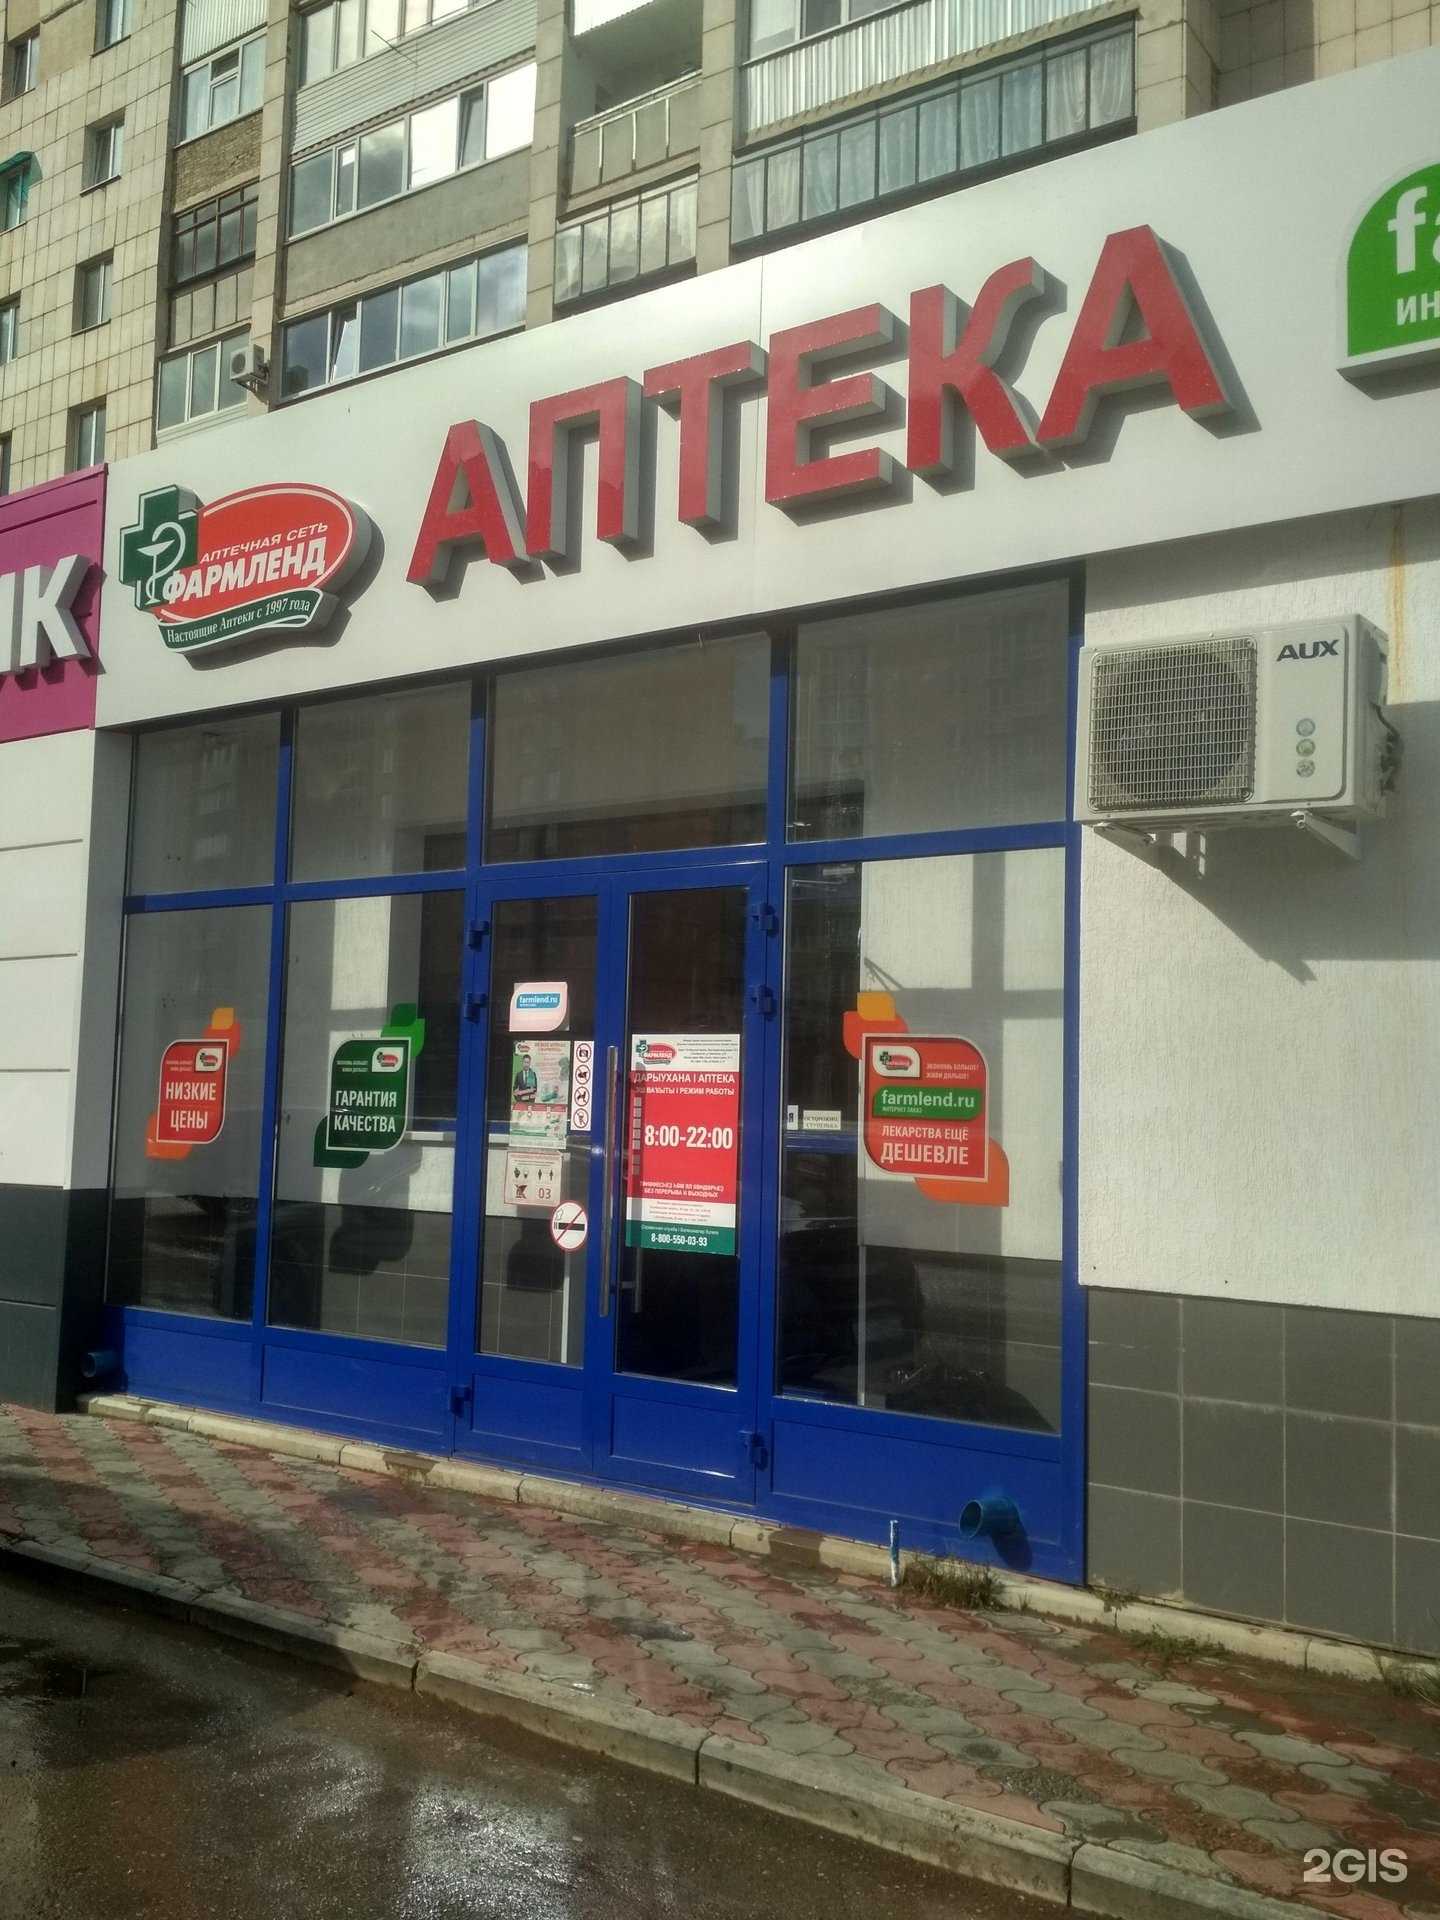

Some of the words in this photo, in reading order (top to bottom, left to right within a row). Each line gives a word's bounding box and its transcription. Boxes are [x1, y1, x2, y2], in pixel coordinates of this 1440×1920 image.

[1387, 186, 1440, 275] f
[406, 224, 1236, 588] АПТЕКА
[200, 534, 282, 564] АПТЕЧНАЯ
[286, 522, 329, 541] СЕТЬ
[162, 536, 327, 605] ФАРМЛЕНД
[0, 554, 92, 672] К
[167, 623, 218, 643] Настоящие
[219, 610, 254, 632] Аптеки
[256, 608, 262, 618] с
[265, 598, 288, 616] 1997
[288, 600, 311, 614] года
[1276, 639, 1340, 662] AUX
[697, 1073, 735, 1084] АПТЕКА
[165, 1082, 217, 1101] НИЗКИЕ
[335, 1090, 397, 1107] ГАРАНТИЯ
[679, 1087, 705, 1095] РЕЖИМ
[705, 1088, 735, 1096] РАБОТЫ
[881, 1089, 975, 1108] farmlend.ru
[170, 1111, 208, 1131] ЦЕНЫ
[334, 1115, 396, 1132] КАЧЕСТВА
[644, 1125, 733, 1149] 8:00-22:00
[881, 1125, 942, 1139] ЛЕКАРСТВА
[880, 1142, 969, 1165] ДЕШЕВЛЕ
[538, 1187, 552, 1199] 03
[650, 1232, 708, 1247] 8-800-550-03-93
